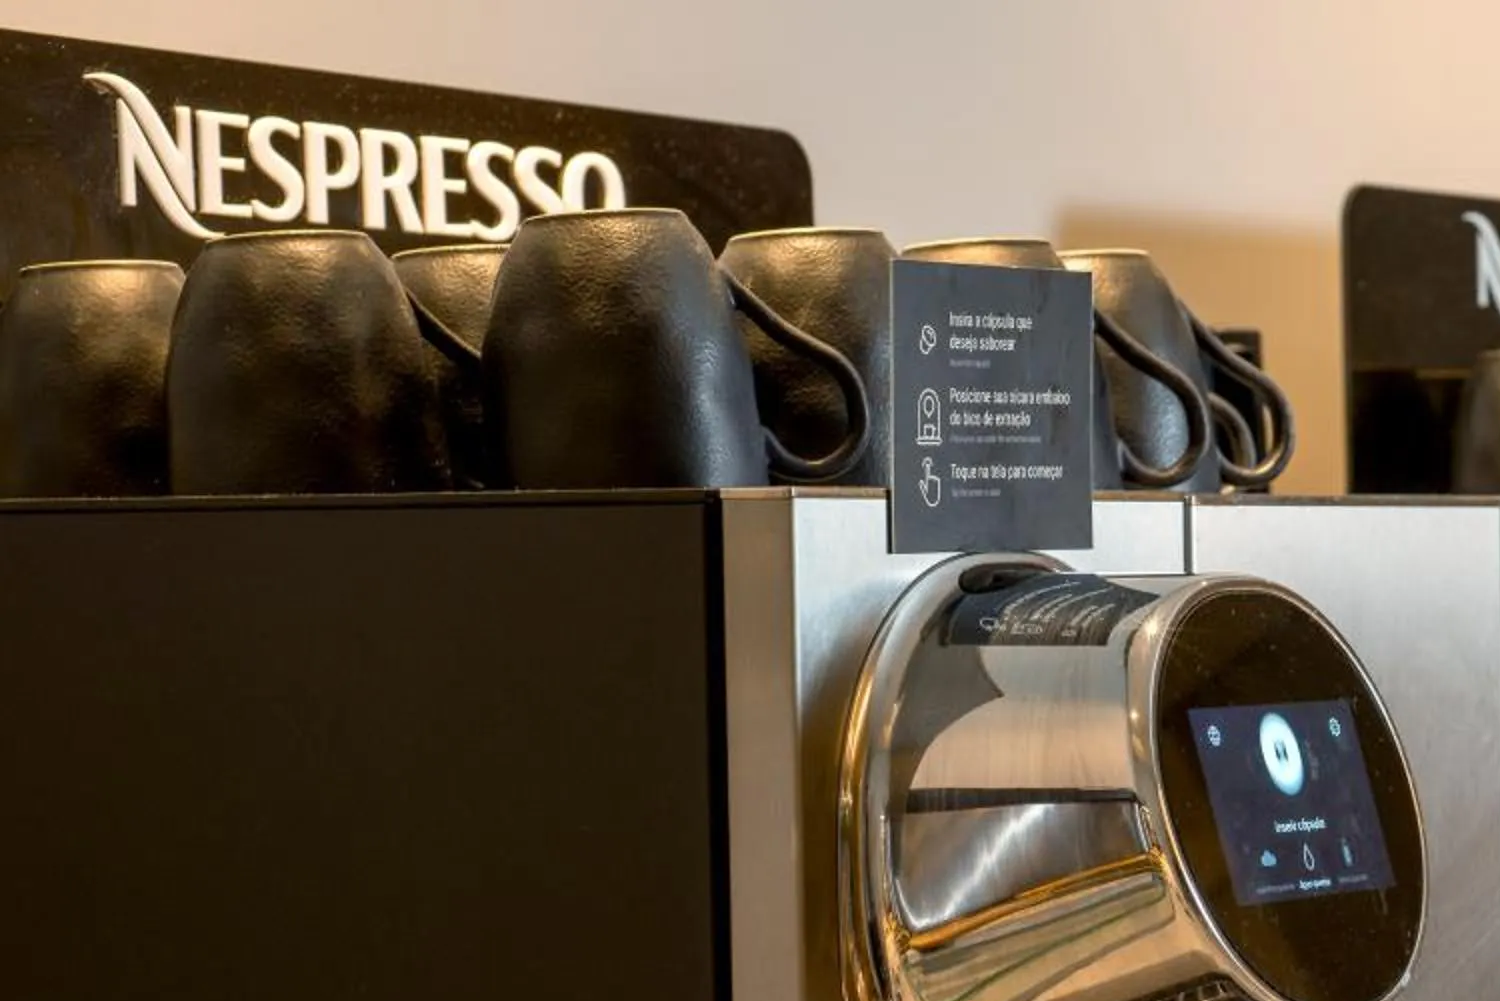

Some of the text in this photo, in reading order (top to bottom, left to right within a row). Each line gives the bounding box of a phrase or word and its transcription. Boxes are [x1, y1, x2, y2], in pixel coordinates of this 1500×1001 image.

[83, 72, 626, 242] NESPRESSO
[950, 387, 991, 403] Posicione
[951, 464, 976, 481] Toque
